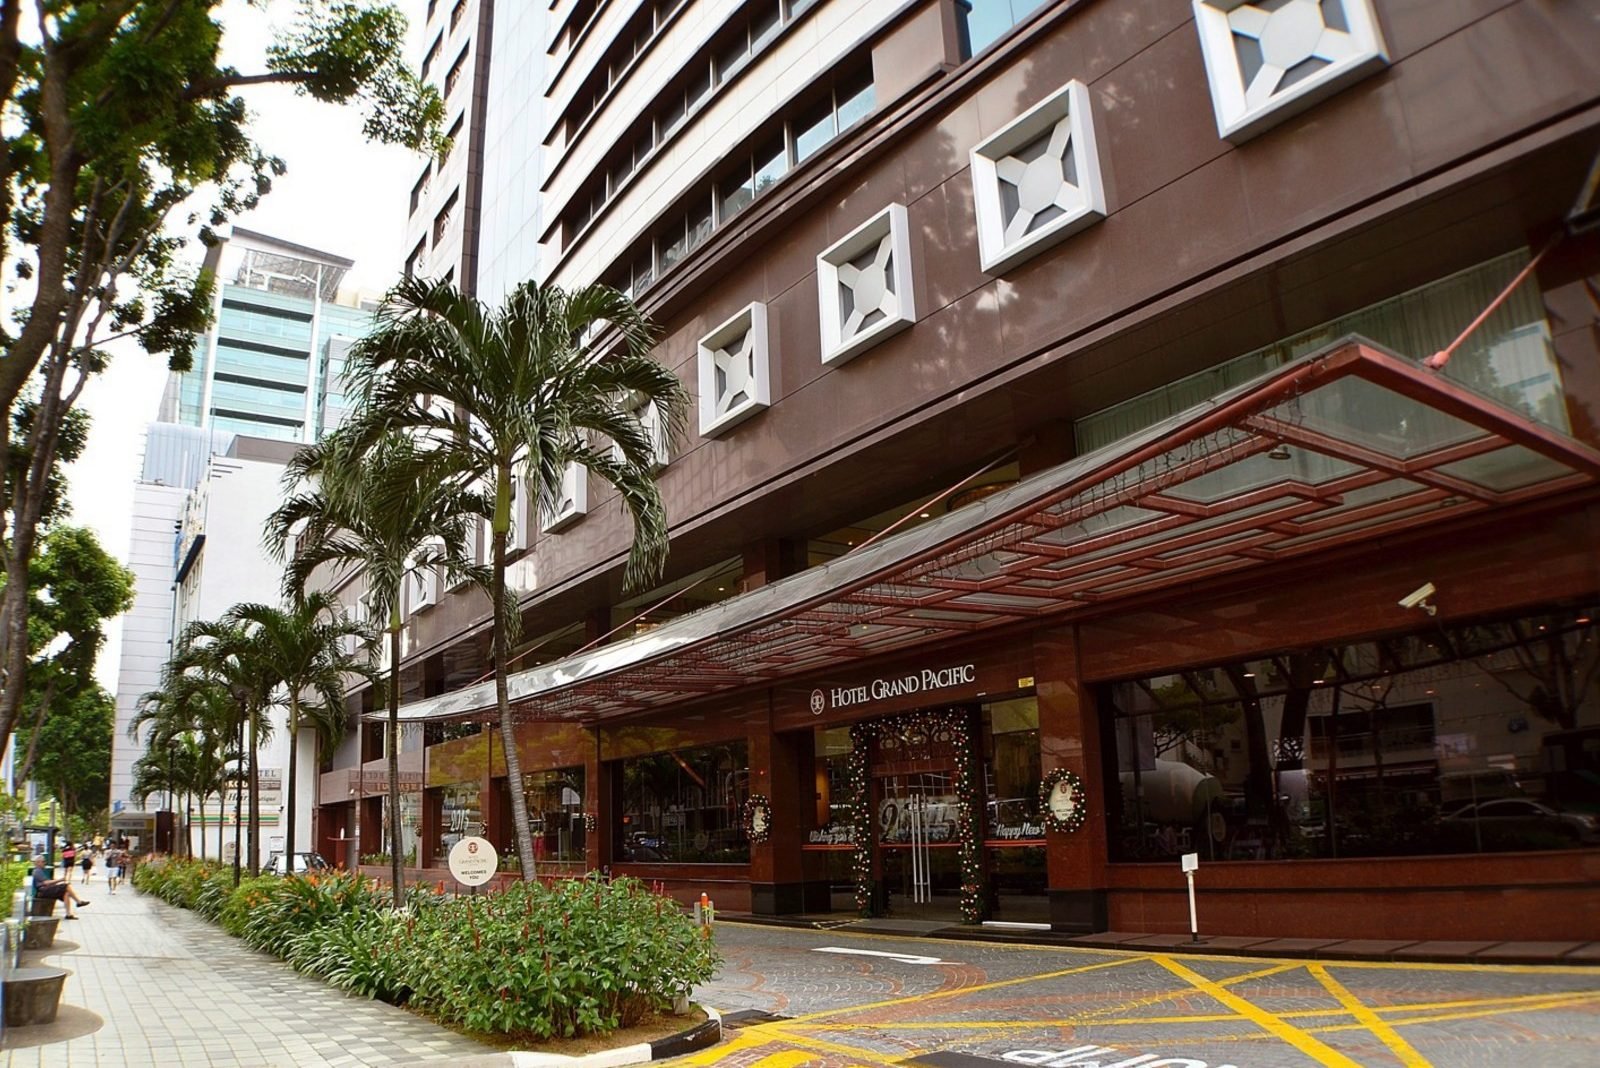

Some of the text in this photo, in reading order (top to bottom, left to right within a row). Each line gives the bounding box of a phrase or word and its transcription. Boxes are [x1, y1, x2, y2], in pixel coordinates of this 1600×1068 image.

[831, 664, 976, 708] HOTEL GRAND PACIFIC
[996, 823, 1021, 840] Happy
[1021, 821, 1041, 836] New
